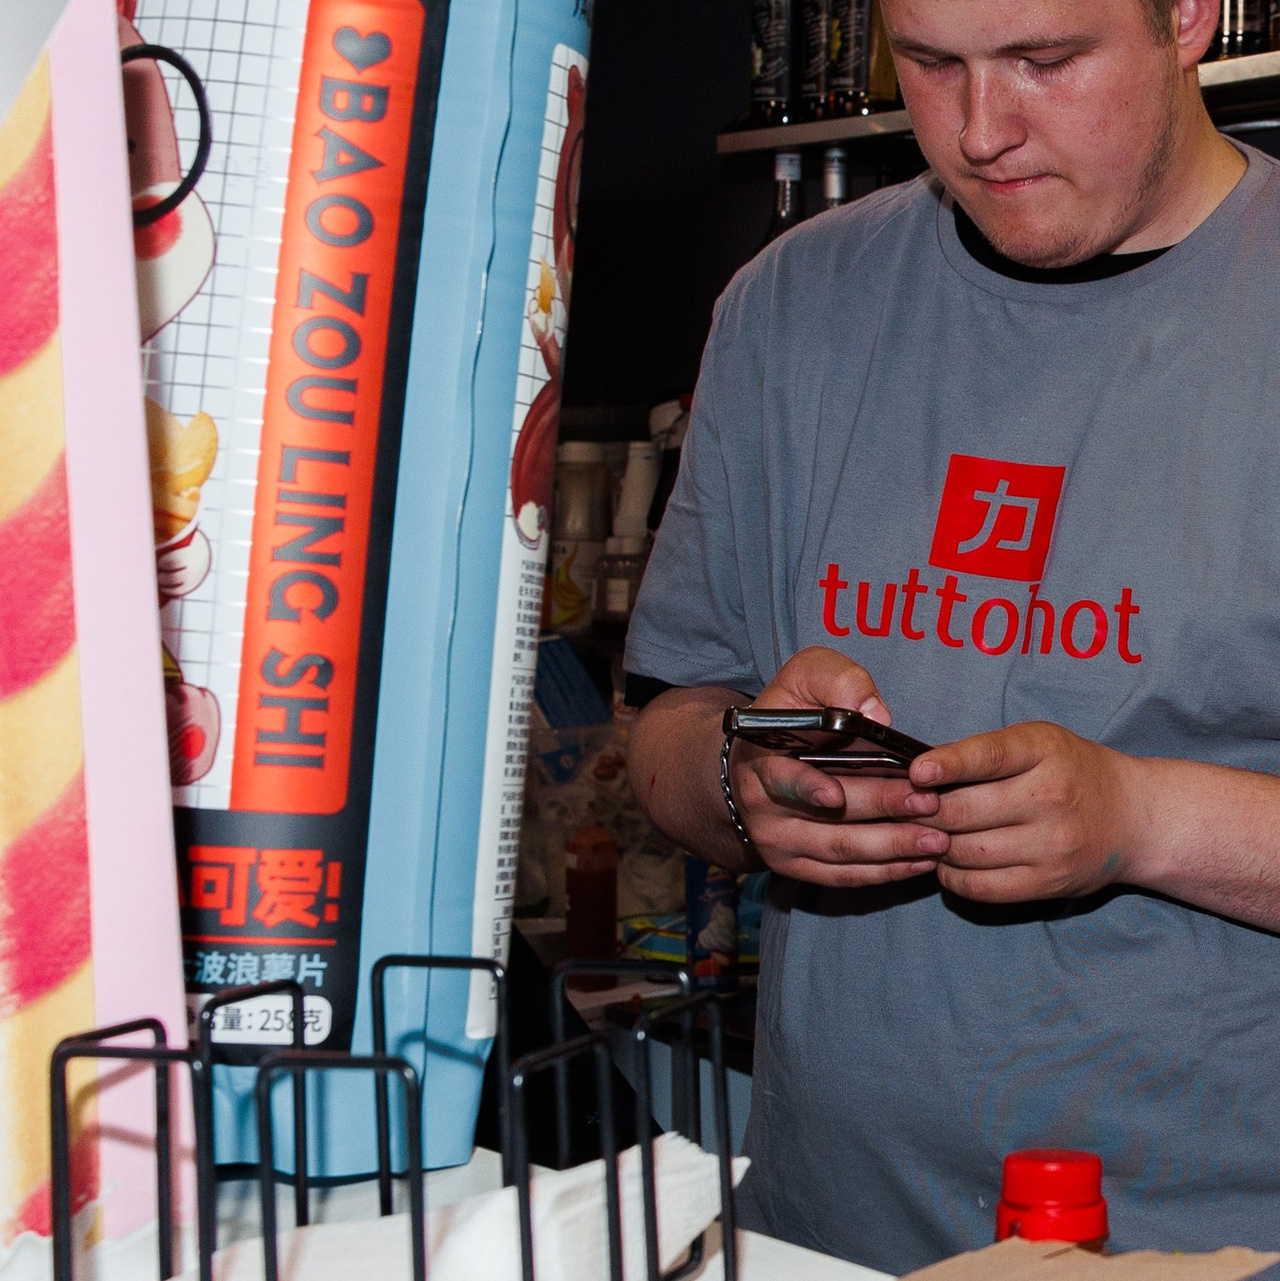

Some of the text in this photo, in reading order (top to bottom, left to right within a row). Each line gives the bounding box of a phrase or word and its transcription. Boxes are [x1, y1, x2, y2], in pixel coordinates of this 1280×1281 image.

[253, 77, 391, 772] BAO ZOU LING SHI
[818, 562, 1143, 665] tuttohot
[188, 845, 343, 929] 可爱!
[186, 951, 329, 988] 波浪薯片
